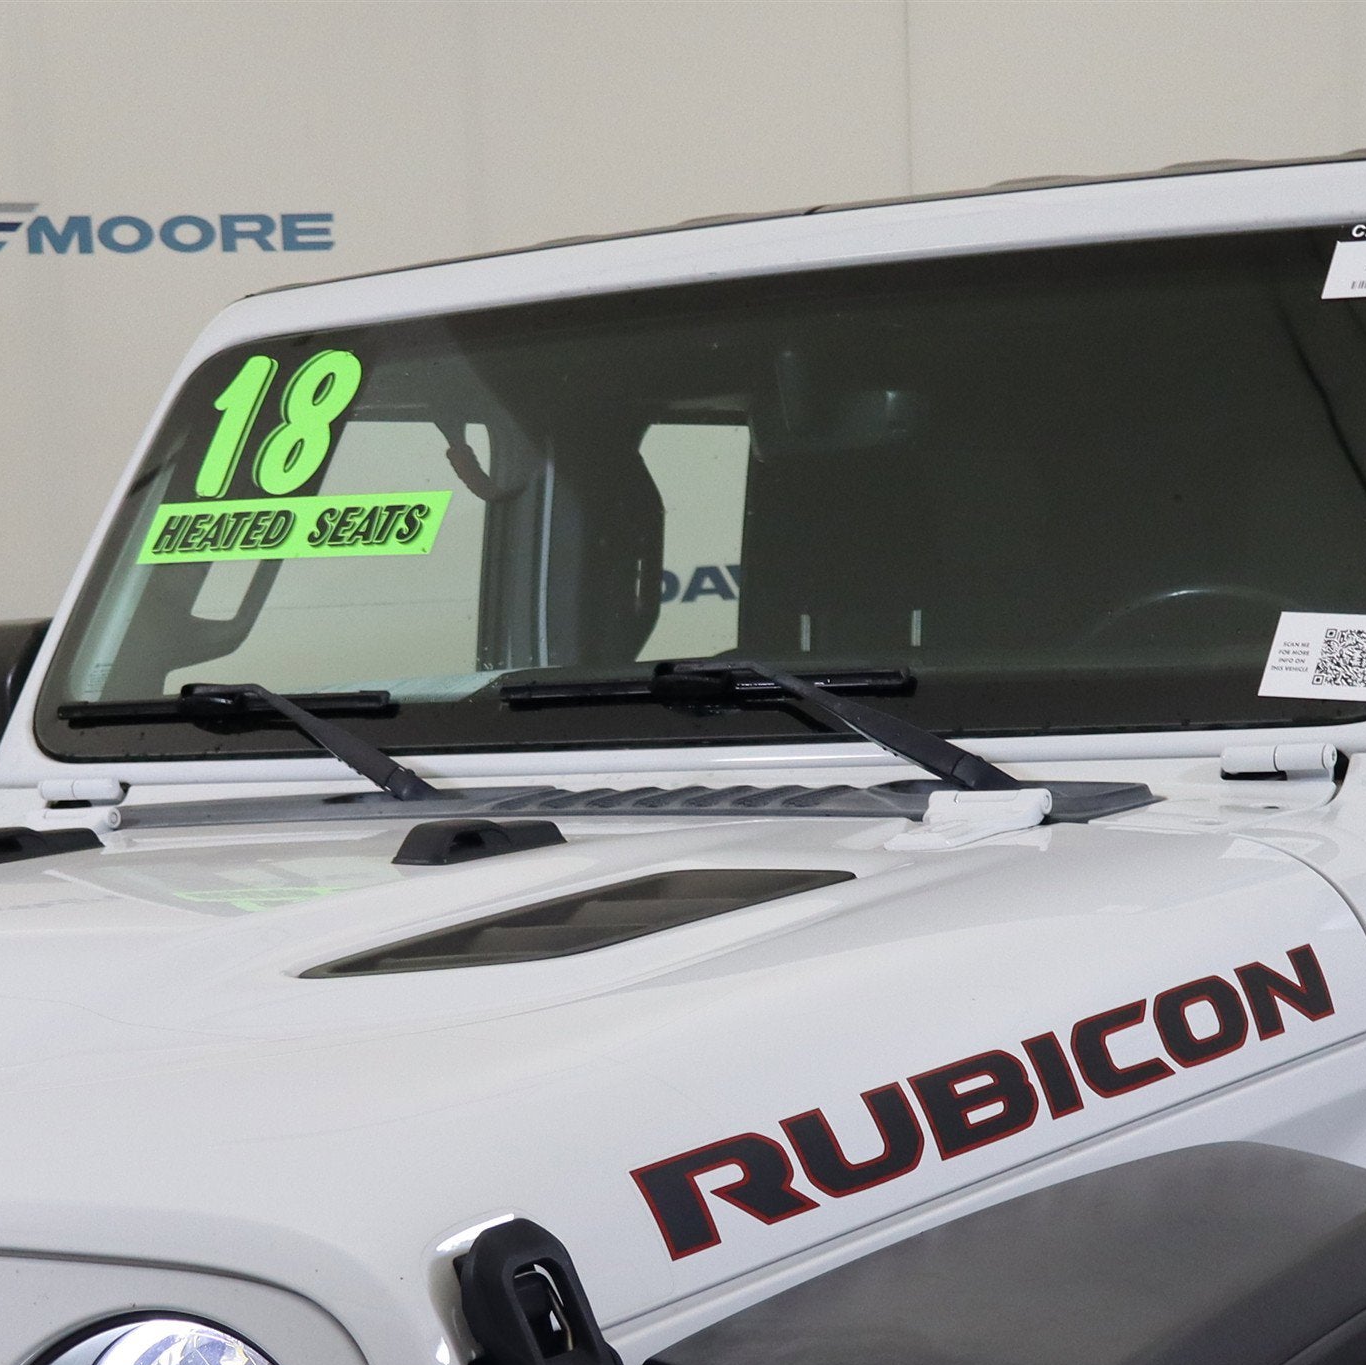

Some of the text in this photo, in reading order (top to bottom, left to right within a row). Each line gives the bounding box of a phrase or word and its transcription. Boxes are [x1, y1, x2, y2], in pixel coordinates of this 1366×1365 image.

[26, 212, 336, 254] MOORE
[195, 349, 363, 498] 18
[152, 503, 431, 554] HEATED SEATS
[629, 943, 1335, 1262] RUBICON
